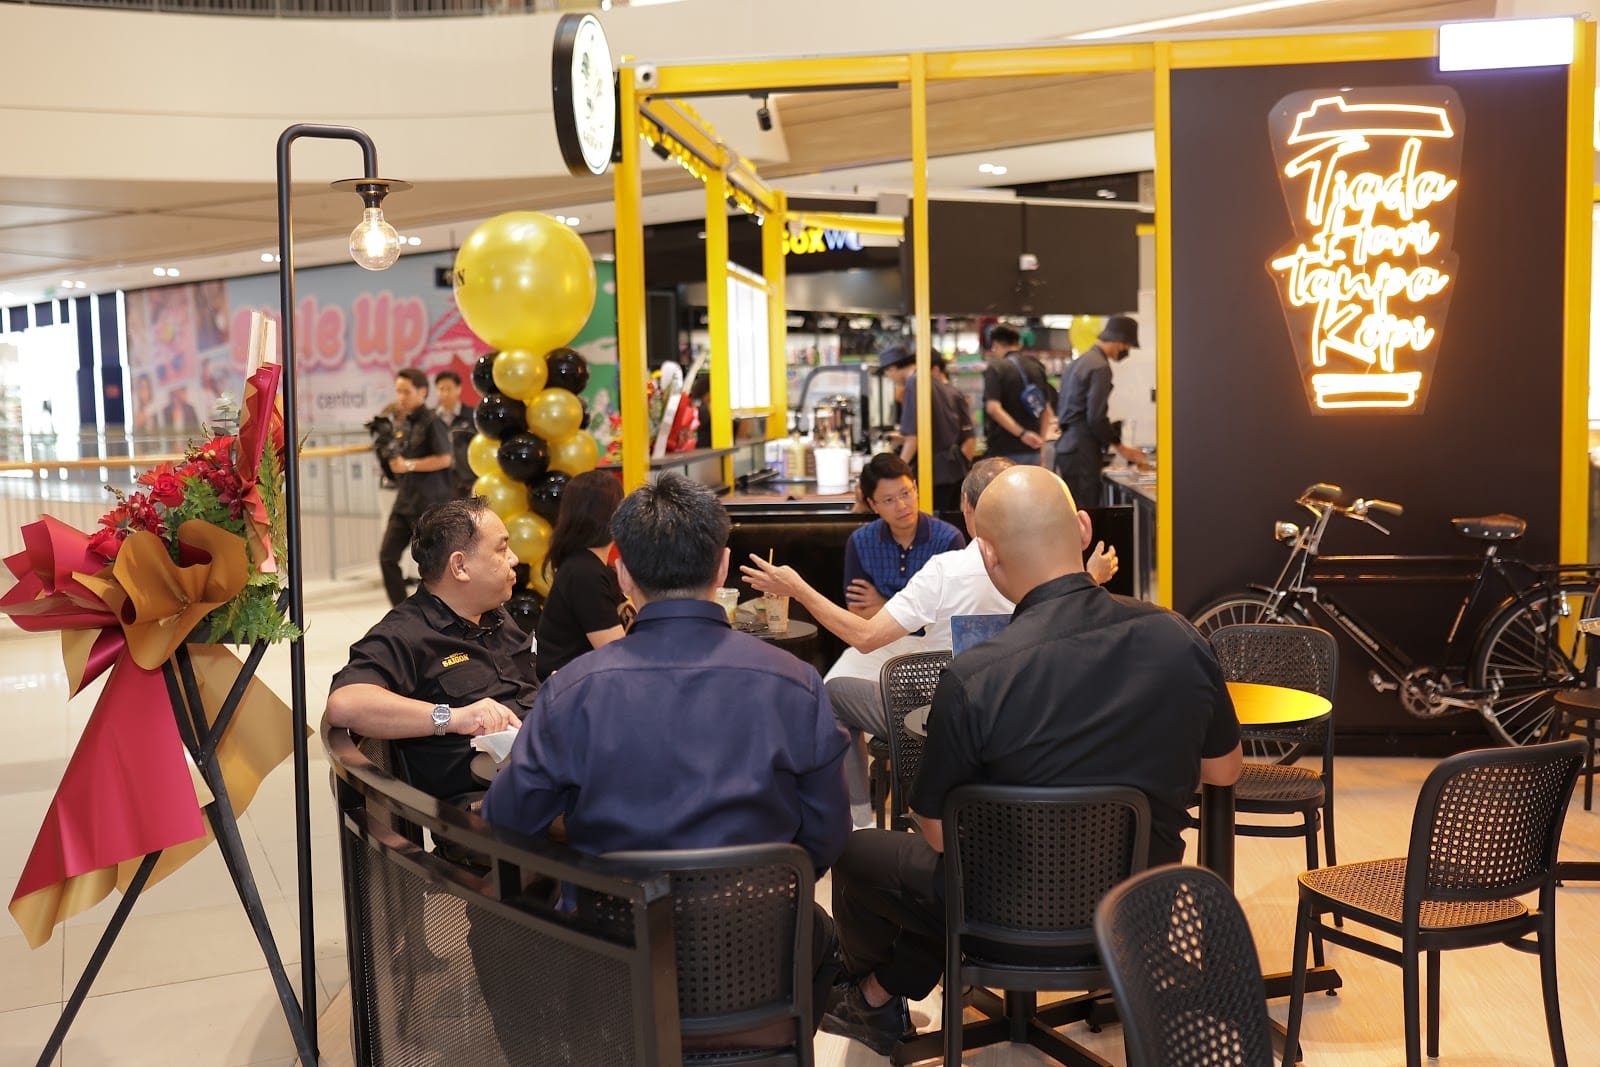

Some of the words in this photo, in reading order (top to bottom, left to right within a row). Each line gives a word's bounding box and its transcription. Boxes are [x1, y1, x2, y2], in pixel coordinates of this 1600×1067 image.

[1284, 135, 1457, 225] Tiada
[1312, 299, 1435, 372] Kopi
[441, 653, 470, 668] SAIGON
